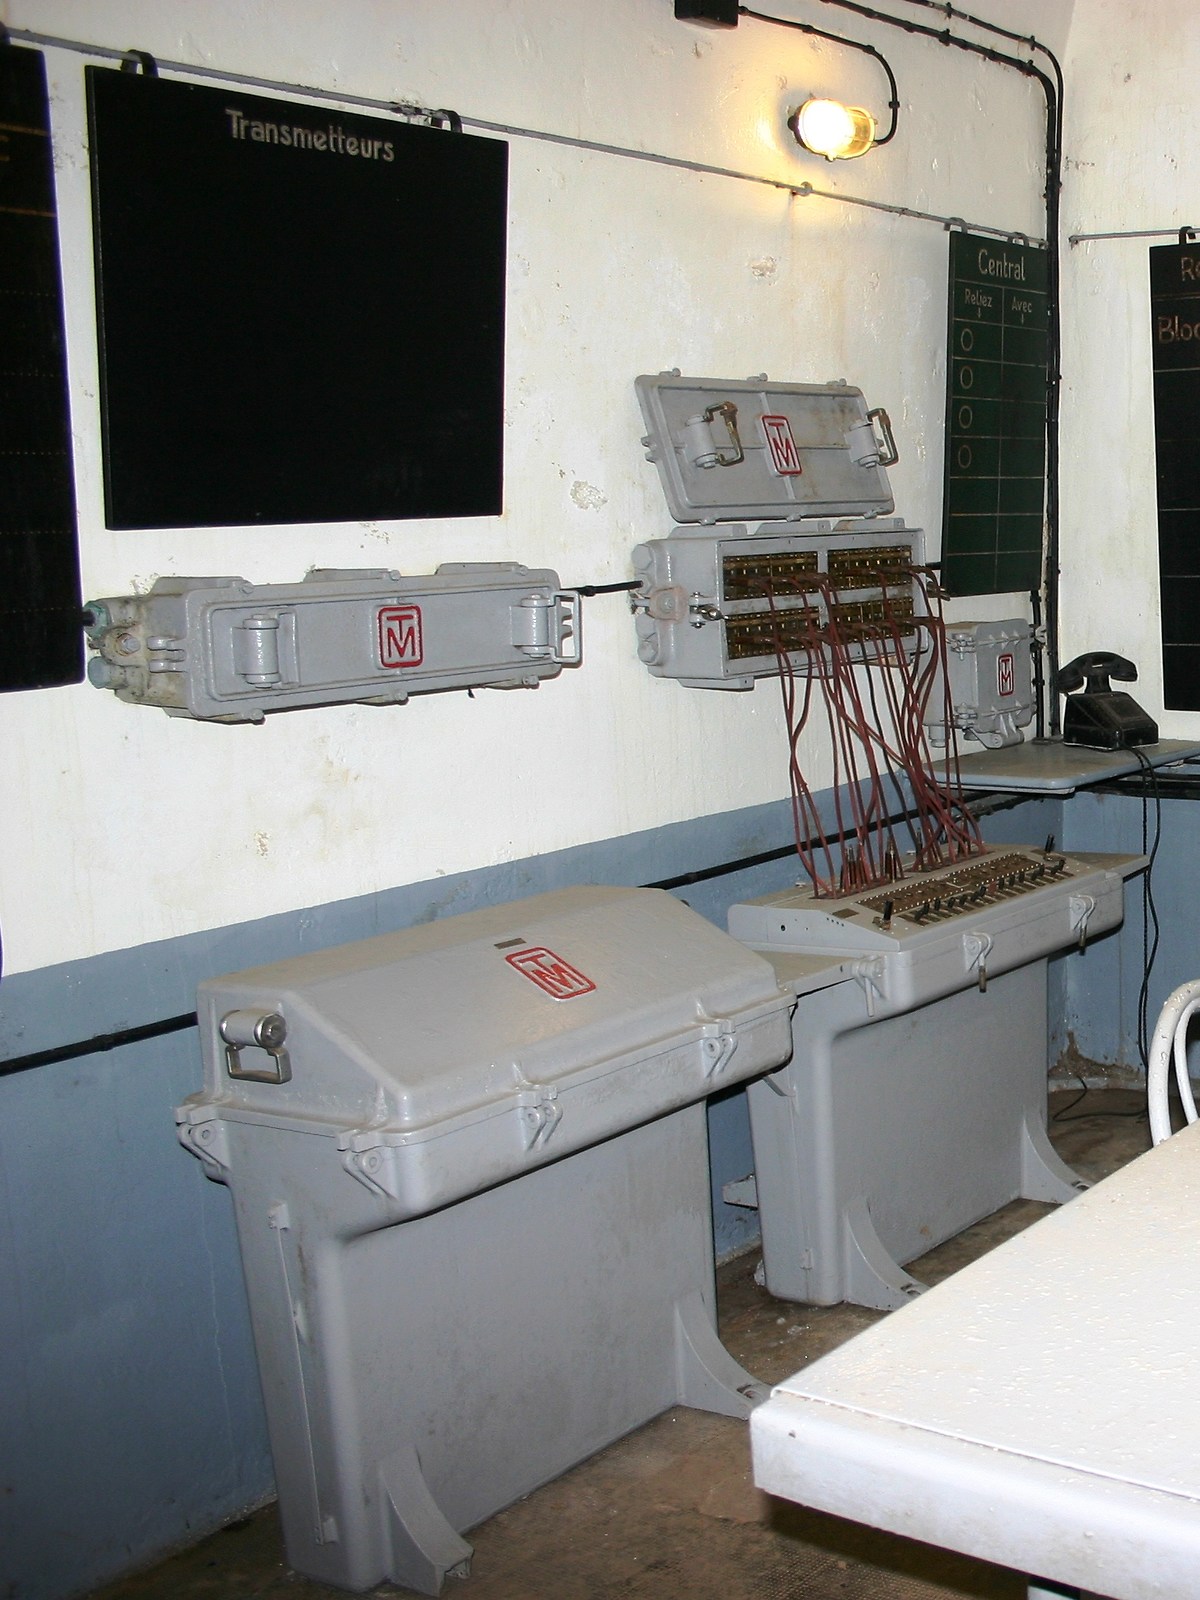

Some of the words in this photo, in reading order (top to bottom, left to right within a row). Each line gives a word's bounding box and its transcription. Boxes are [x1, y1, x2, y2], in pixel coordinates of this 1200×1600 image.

[225, 108, 396, 162] Transmetteurs
[978, 248, 1026, 281] Central
[1011, 295, 1032, 313] Avec
